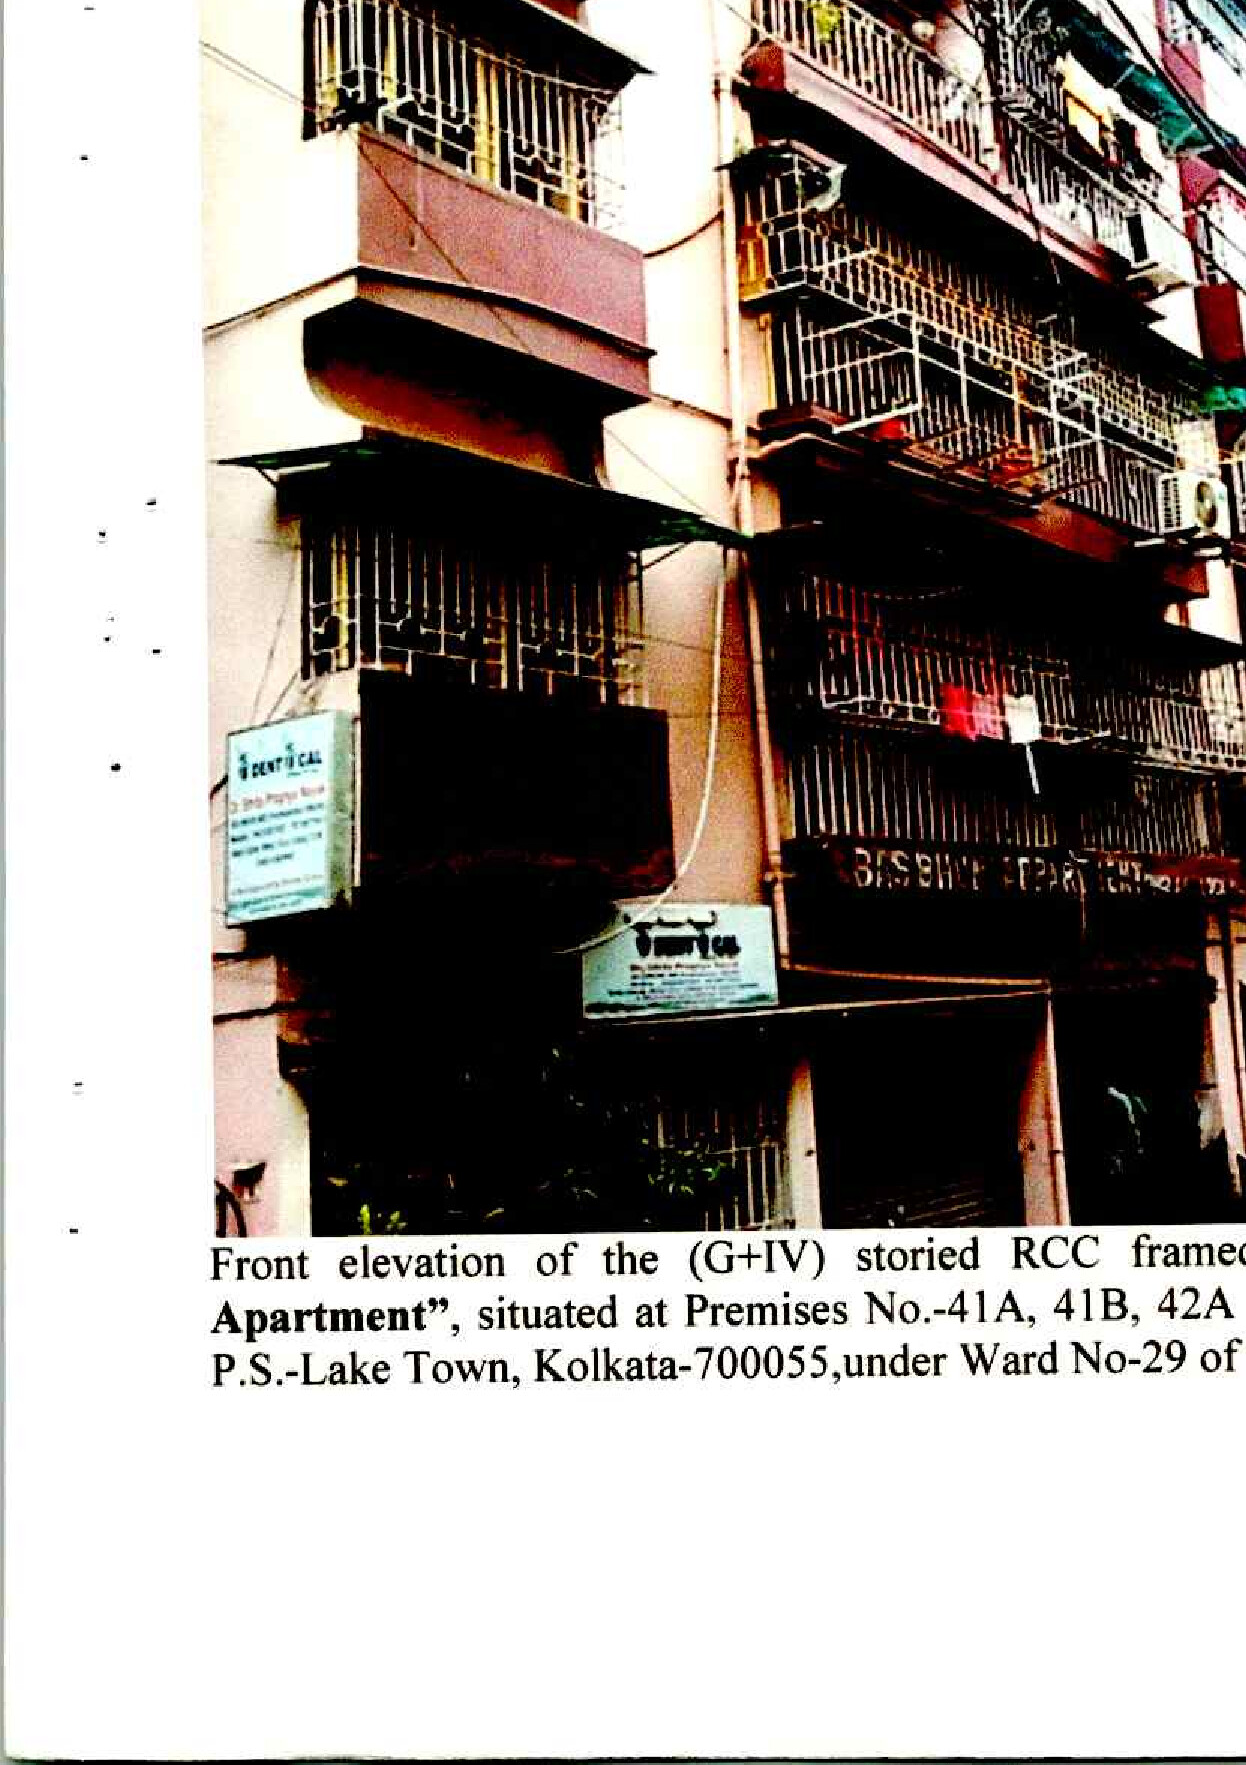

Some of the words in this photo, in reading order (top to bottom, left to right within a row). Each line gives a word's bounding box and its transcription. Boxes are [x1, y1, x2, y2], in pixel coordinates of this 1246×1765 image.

[213, 1247, 309, 1280] Front
[339, 1243, 504, 1279] elevation
[537, 1243, 577, 1276] of
[603, 1241, 658, 1274] the
[690, 1240, 825, 1281] (G+IV)
[858, 1237, 979, 1271] storied
[1014, 1235, 1098, 1268] RCC
[211, 1298, 459, 1342] Apartment”,
[480, 1295, 616, 1330] situated
[636, 1300, 667, 1327] at
[687, 1292, 847, 1327] Premises
[864, 1291, 1035, 1327] No.-41A,
[1054, 1288, 1140, 1325] 41B,
[1158, 1286, 1234, 1319] 42A
[214, 1352, 390, 1385] P.S.-Lake
[403, 1351, 520, 1388] Town,
[535, 1343, 946, 1384] Kolkata-700055,under
[961, 1340, 1057, 1375] Ward
[1071, 1340, 1186, 1373] No-29
[1201, 1339, 1242, 1372] of
